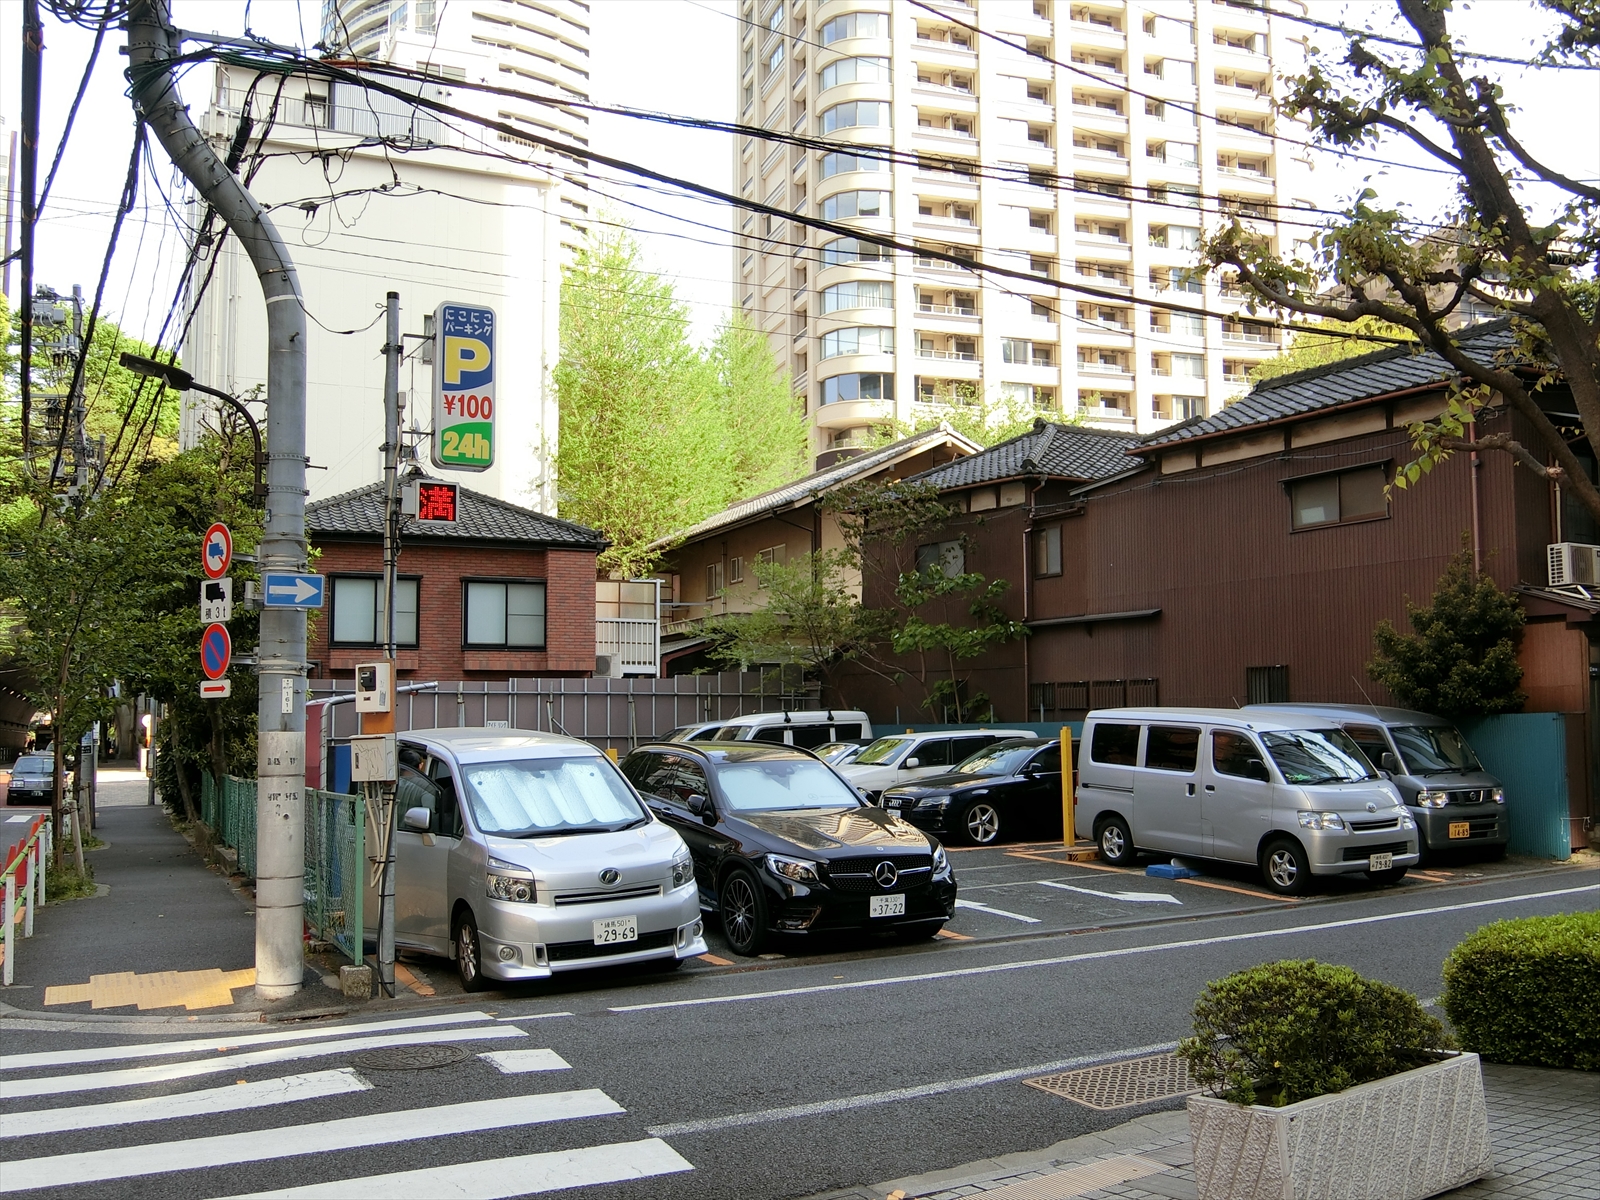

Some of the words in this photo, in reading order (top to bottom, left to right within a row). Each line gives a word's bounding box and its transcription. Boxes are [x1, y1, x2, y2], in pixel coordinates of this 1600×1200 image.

[445, 308, 492, 325] にこにこ
[445, 323, 493, 337] パーキング
[443, 335, 492, 385] P
[443, 394, 493, 420] ¥100
[443, 430, 490, 460] 24h
[419, 486, 454, 521] 満
[878, 902, 904, 915] 37-22
[604, 926, 636, 942] 29-69
